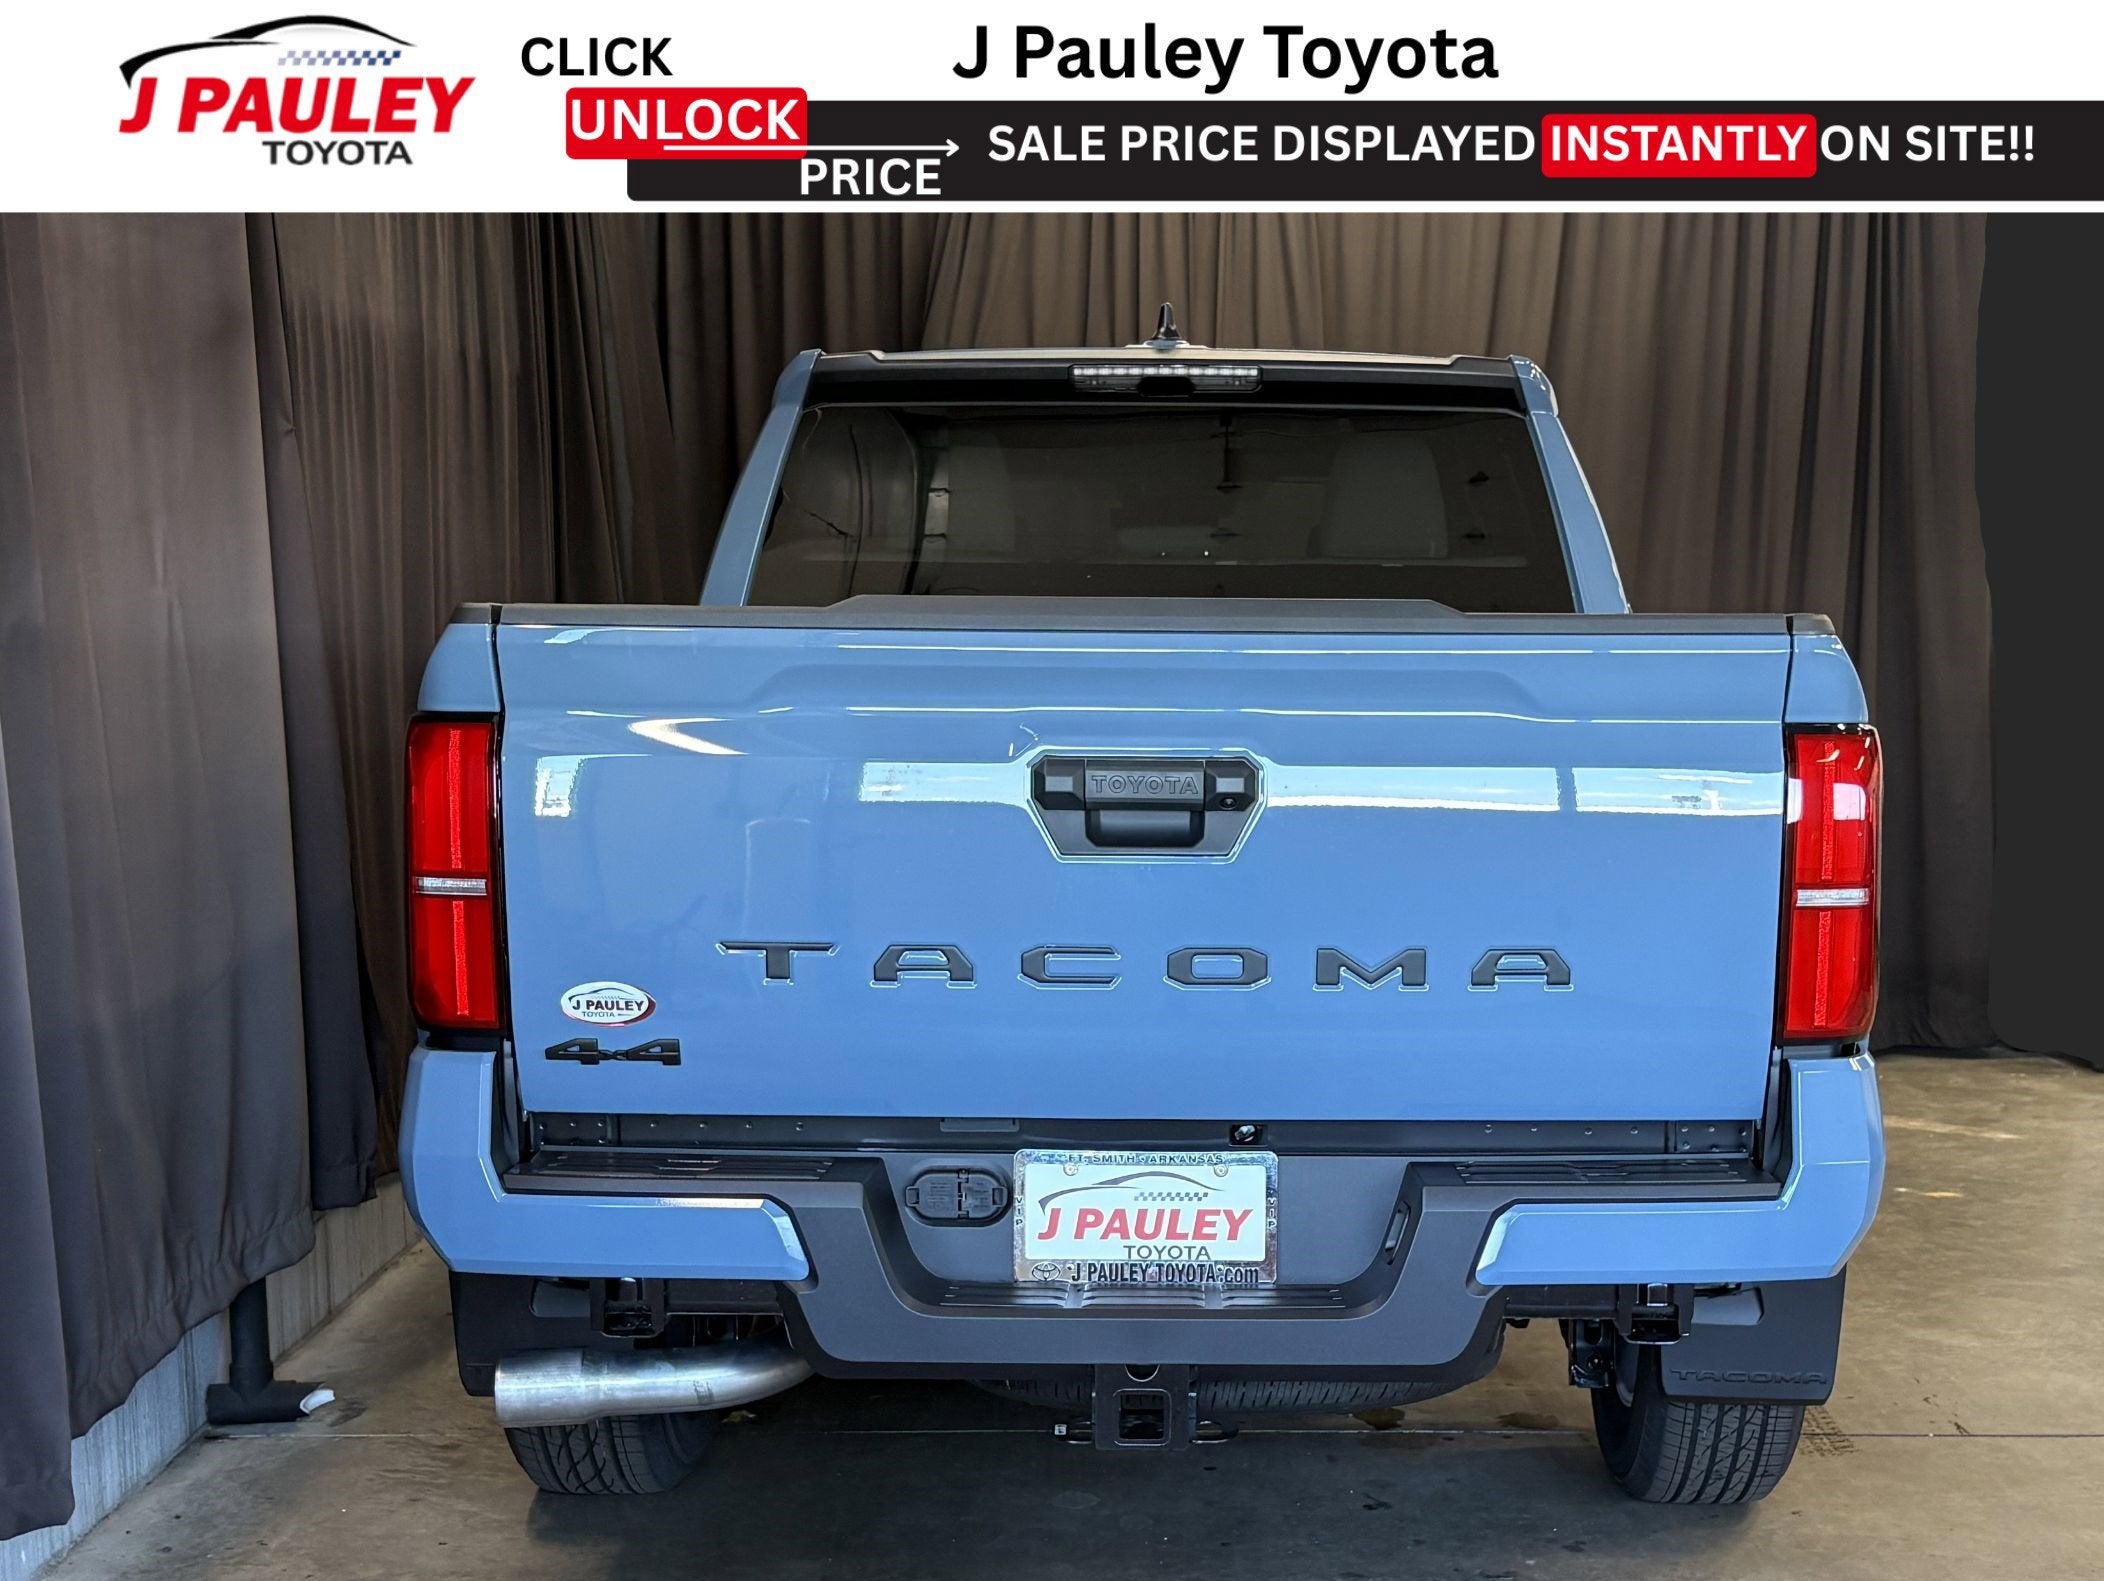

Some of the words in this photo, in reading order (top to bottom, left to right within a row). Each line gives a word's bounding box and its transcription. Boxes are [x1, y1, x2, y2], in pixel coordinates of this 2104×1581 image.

[1091, 774, 1199, 795] TOYOTA
[715, 940, 1575, 993] TACOMA
[572, 1000, 581, 1011] J
[586, 1000, 645, 1012] PAULEY
[1093, 1154, 1135, 1163] SMITH
[1150, 1154, 1224, 1163] ARKANSAS
[1037, 1207, 1062, 1240] J
[1073, 1208, 1253, 1241] PAULEY
[1123, 1245, 1211, 1260] TOYOTA
[1072, 1263, 1081, 1282] J
[1087, 1263, 1150, 1282] PAULEY
[1671, 1370, 1827, 1385] TACOMA
